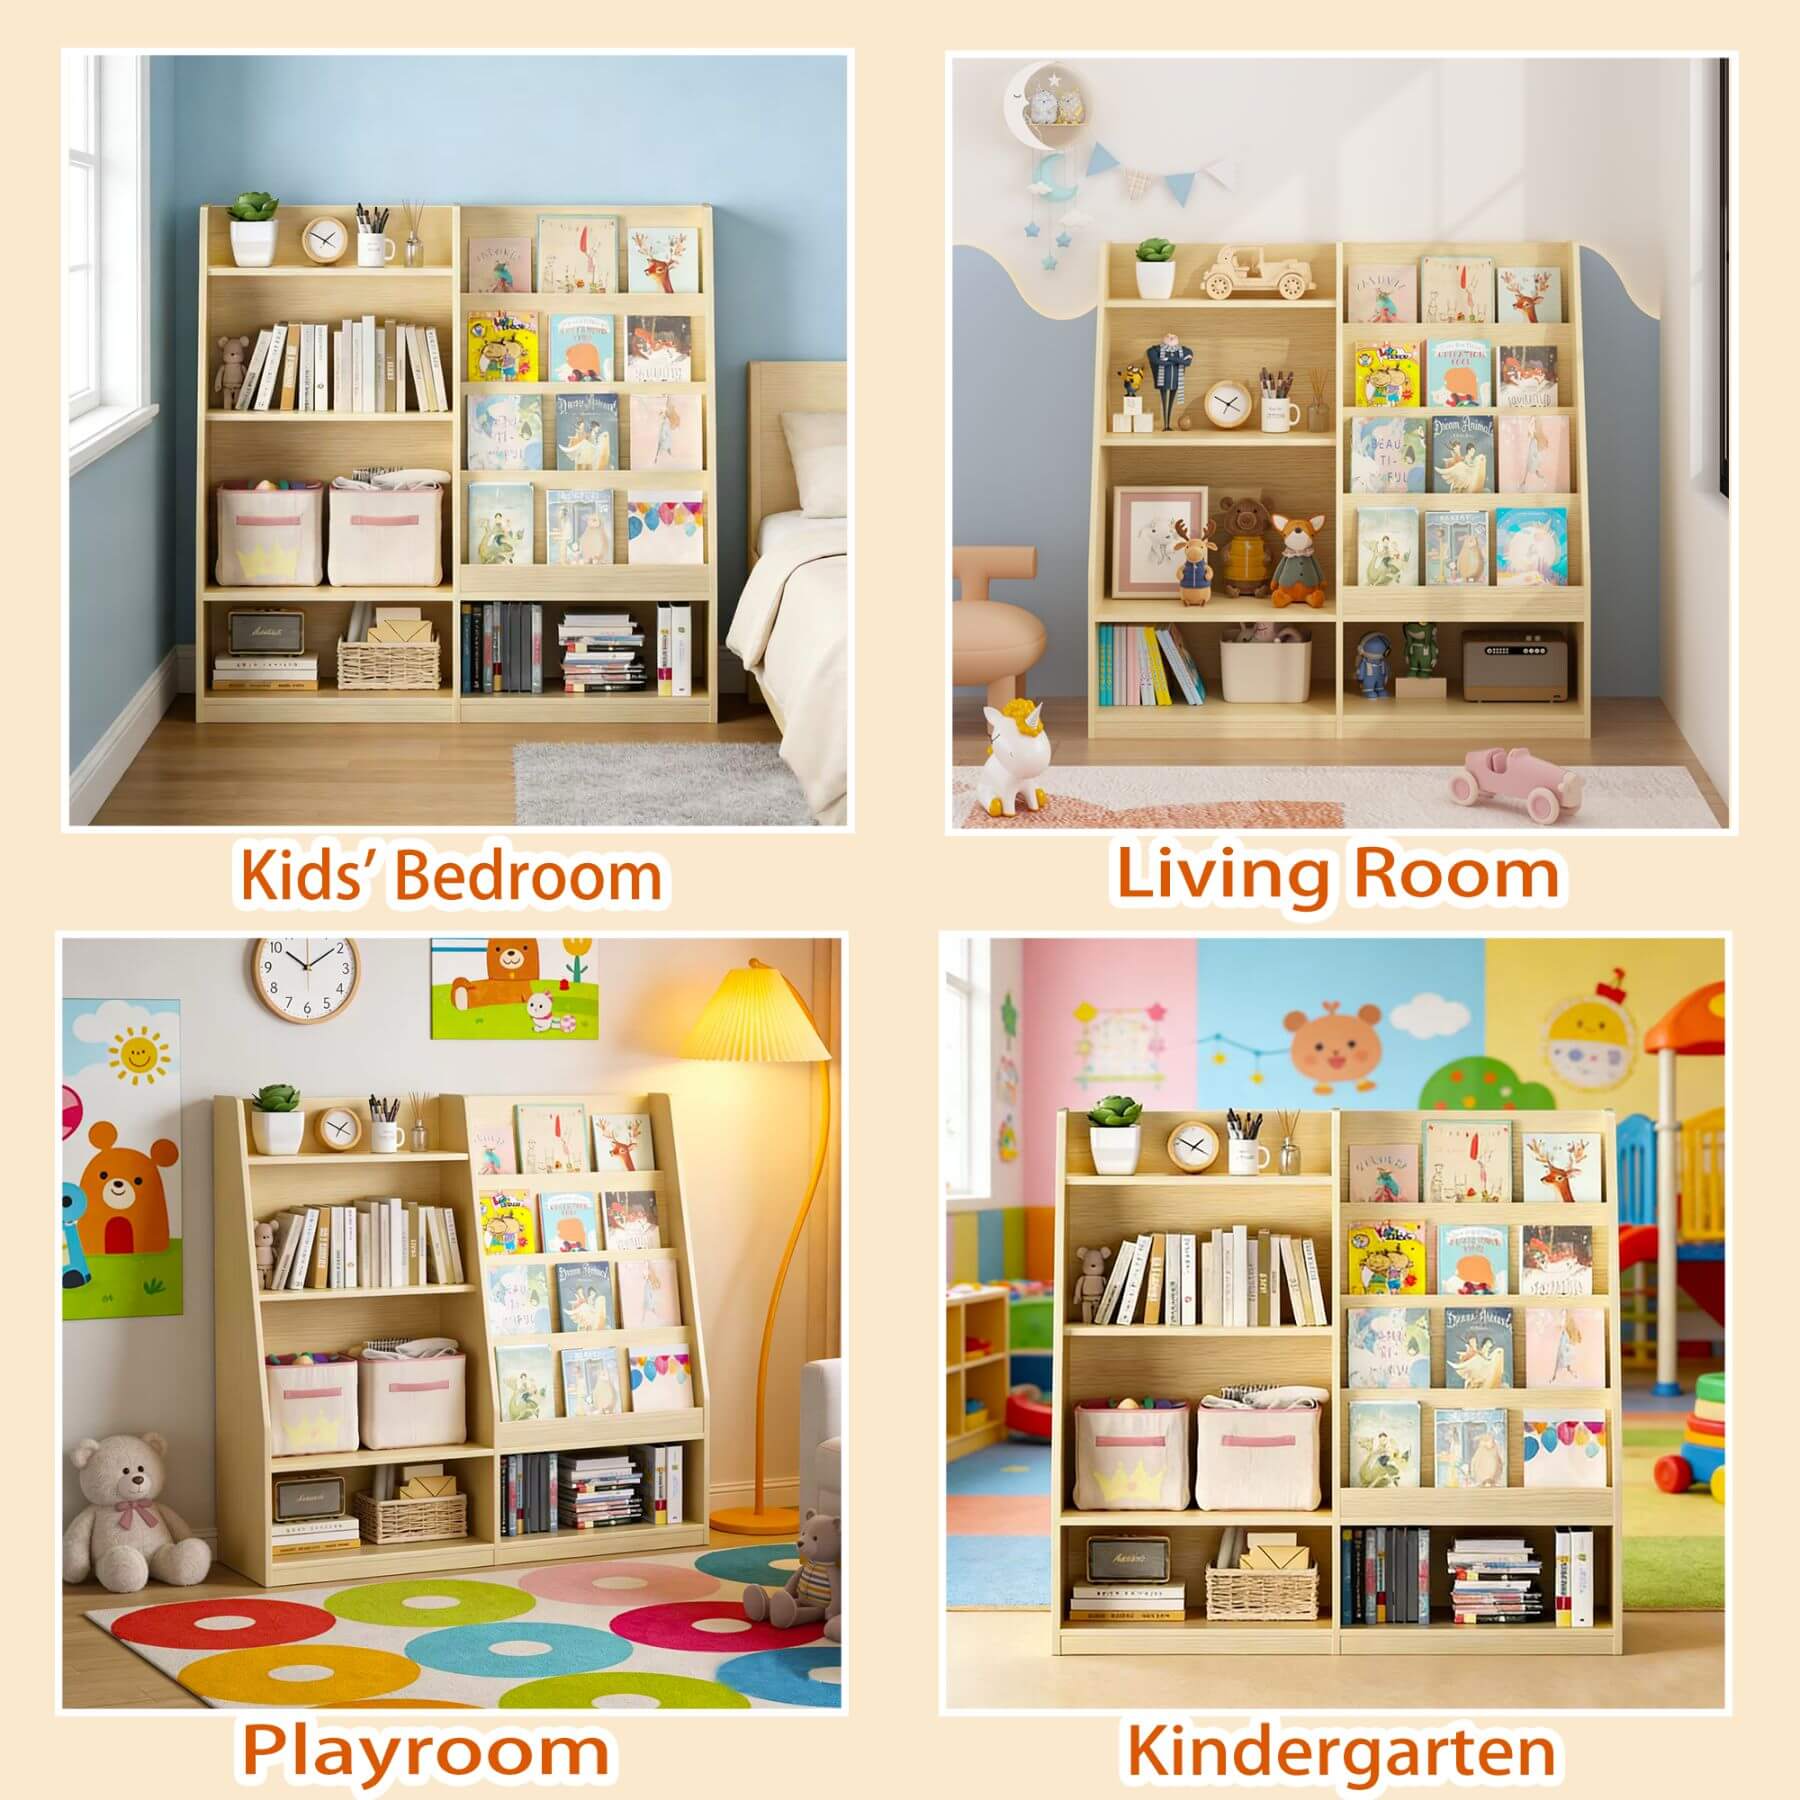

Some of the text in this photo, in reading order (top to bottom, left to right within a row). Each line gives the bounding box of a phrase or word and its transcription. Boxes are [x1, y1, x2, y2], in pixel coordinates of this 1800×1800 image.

[270, 941, 283, 954] 10
[336, 942, 344, 954] 2
[264, 961, 272, 973] 9
[342, 962, 350, 975] 3
[270, 982, 278, 994] 8
[336, 982, 344, 995] 4
[285, 996, 293, 1009] 7
[303, 1001, 312, 1014] 6
[323, 997, 331, 1009] 5
